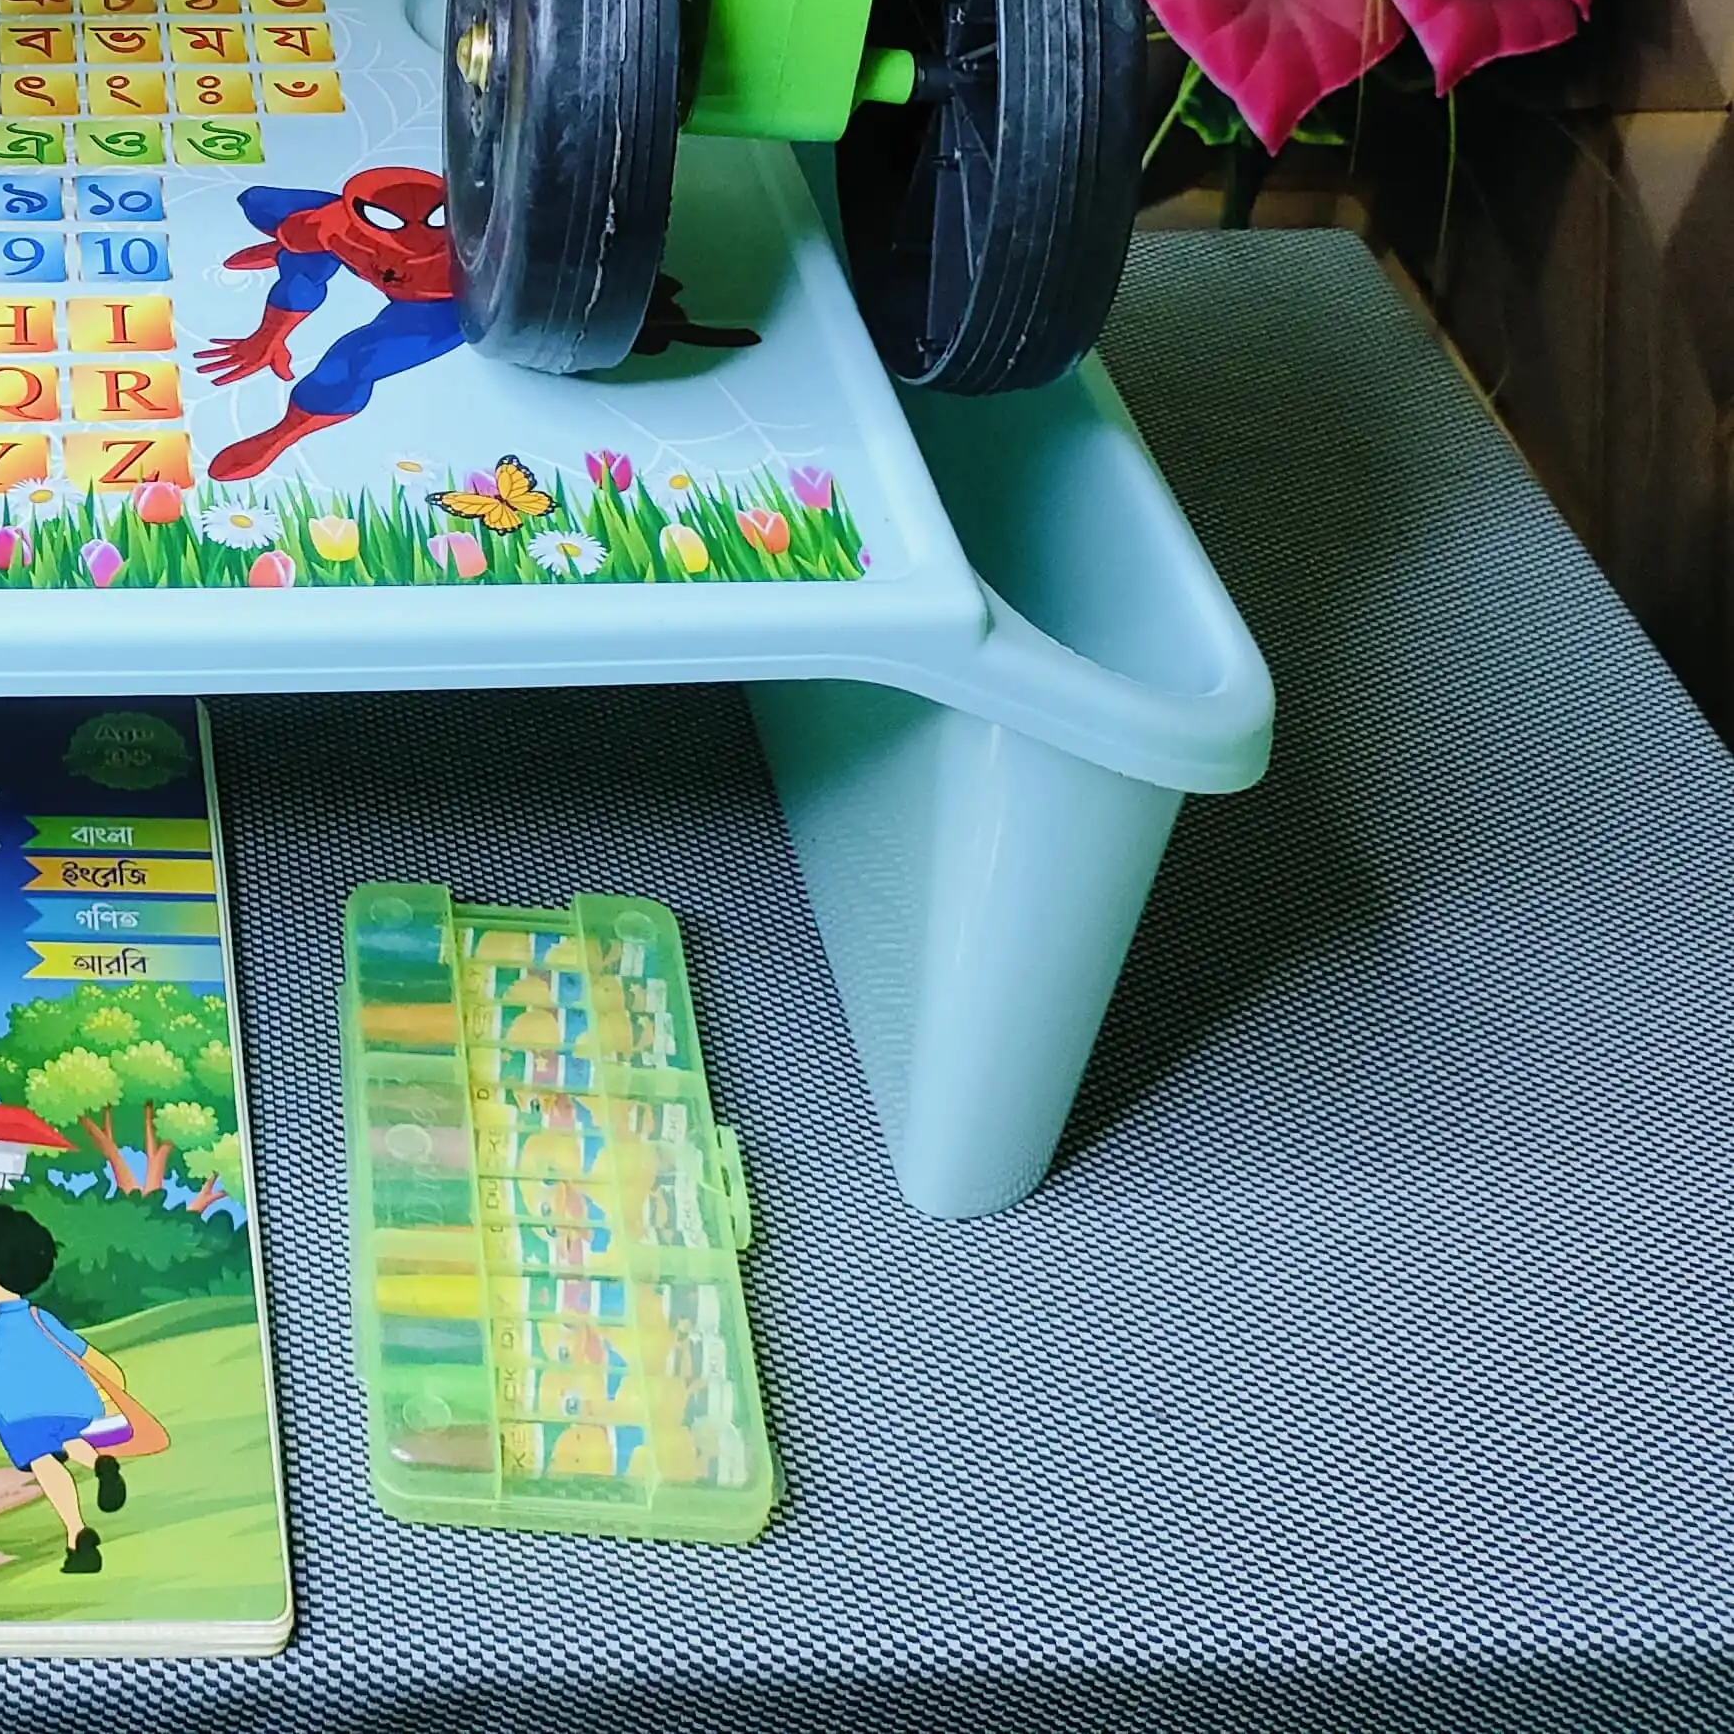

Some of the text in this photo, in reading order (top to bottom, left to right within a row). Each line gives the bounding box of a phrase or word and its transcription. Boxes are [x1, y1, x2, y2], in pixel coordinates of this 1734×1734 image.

[6, 27, 61, 57] ব
[88, 25, 149, 53] ভ
[175, 26, 234, 57] ম
[263, 26, 317, 56] য
[14, 75, 56, 106] ৎ
[90, 129, 148, 159] ও
[186, 120, 255, 160] ঔ
[4, 182, 48, 214] ৯
[88, 183, 153, 215] ১০
[3, 237, 45, 276] 9
[94, 237, 159, 276] 10
[105, 304, 135, 345] I
[100, 370, 169, 413] R
[98, 441, 161, 484] Z
[71, 825, 134, 848] বাংলা
[61, 860, 149, 889] ইংরেজি
[74, 902, 140, 931] গণিত
[72, 947, 149, 976] আরবি
